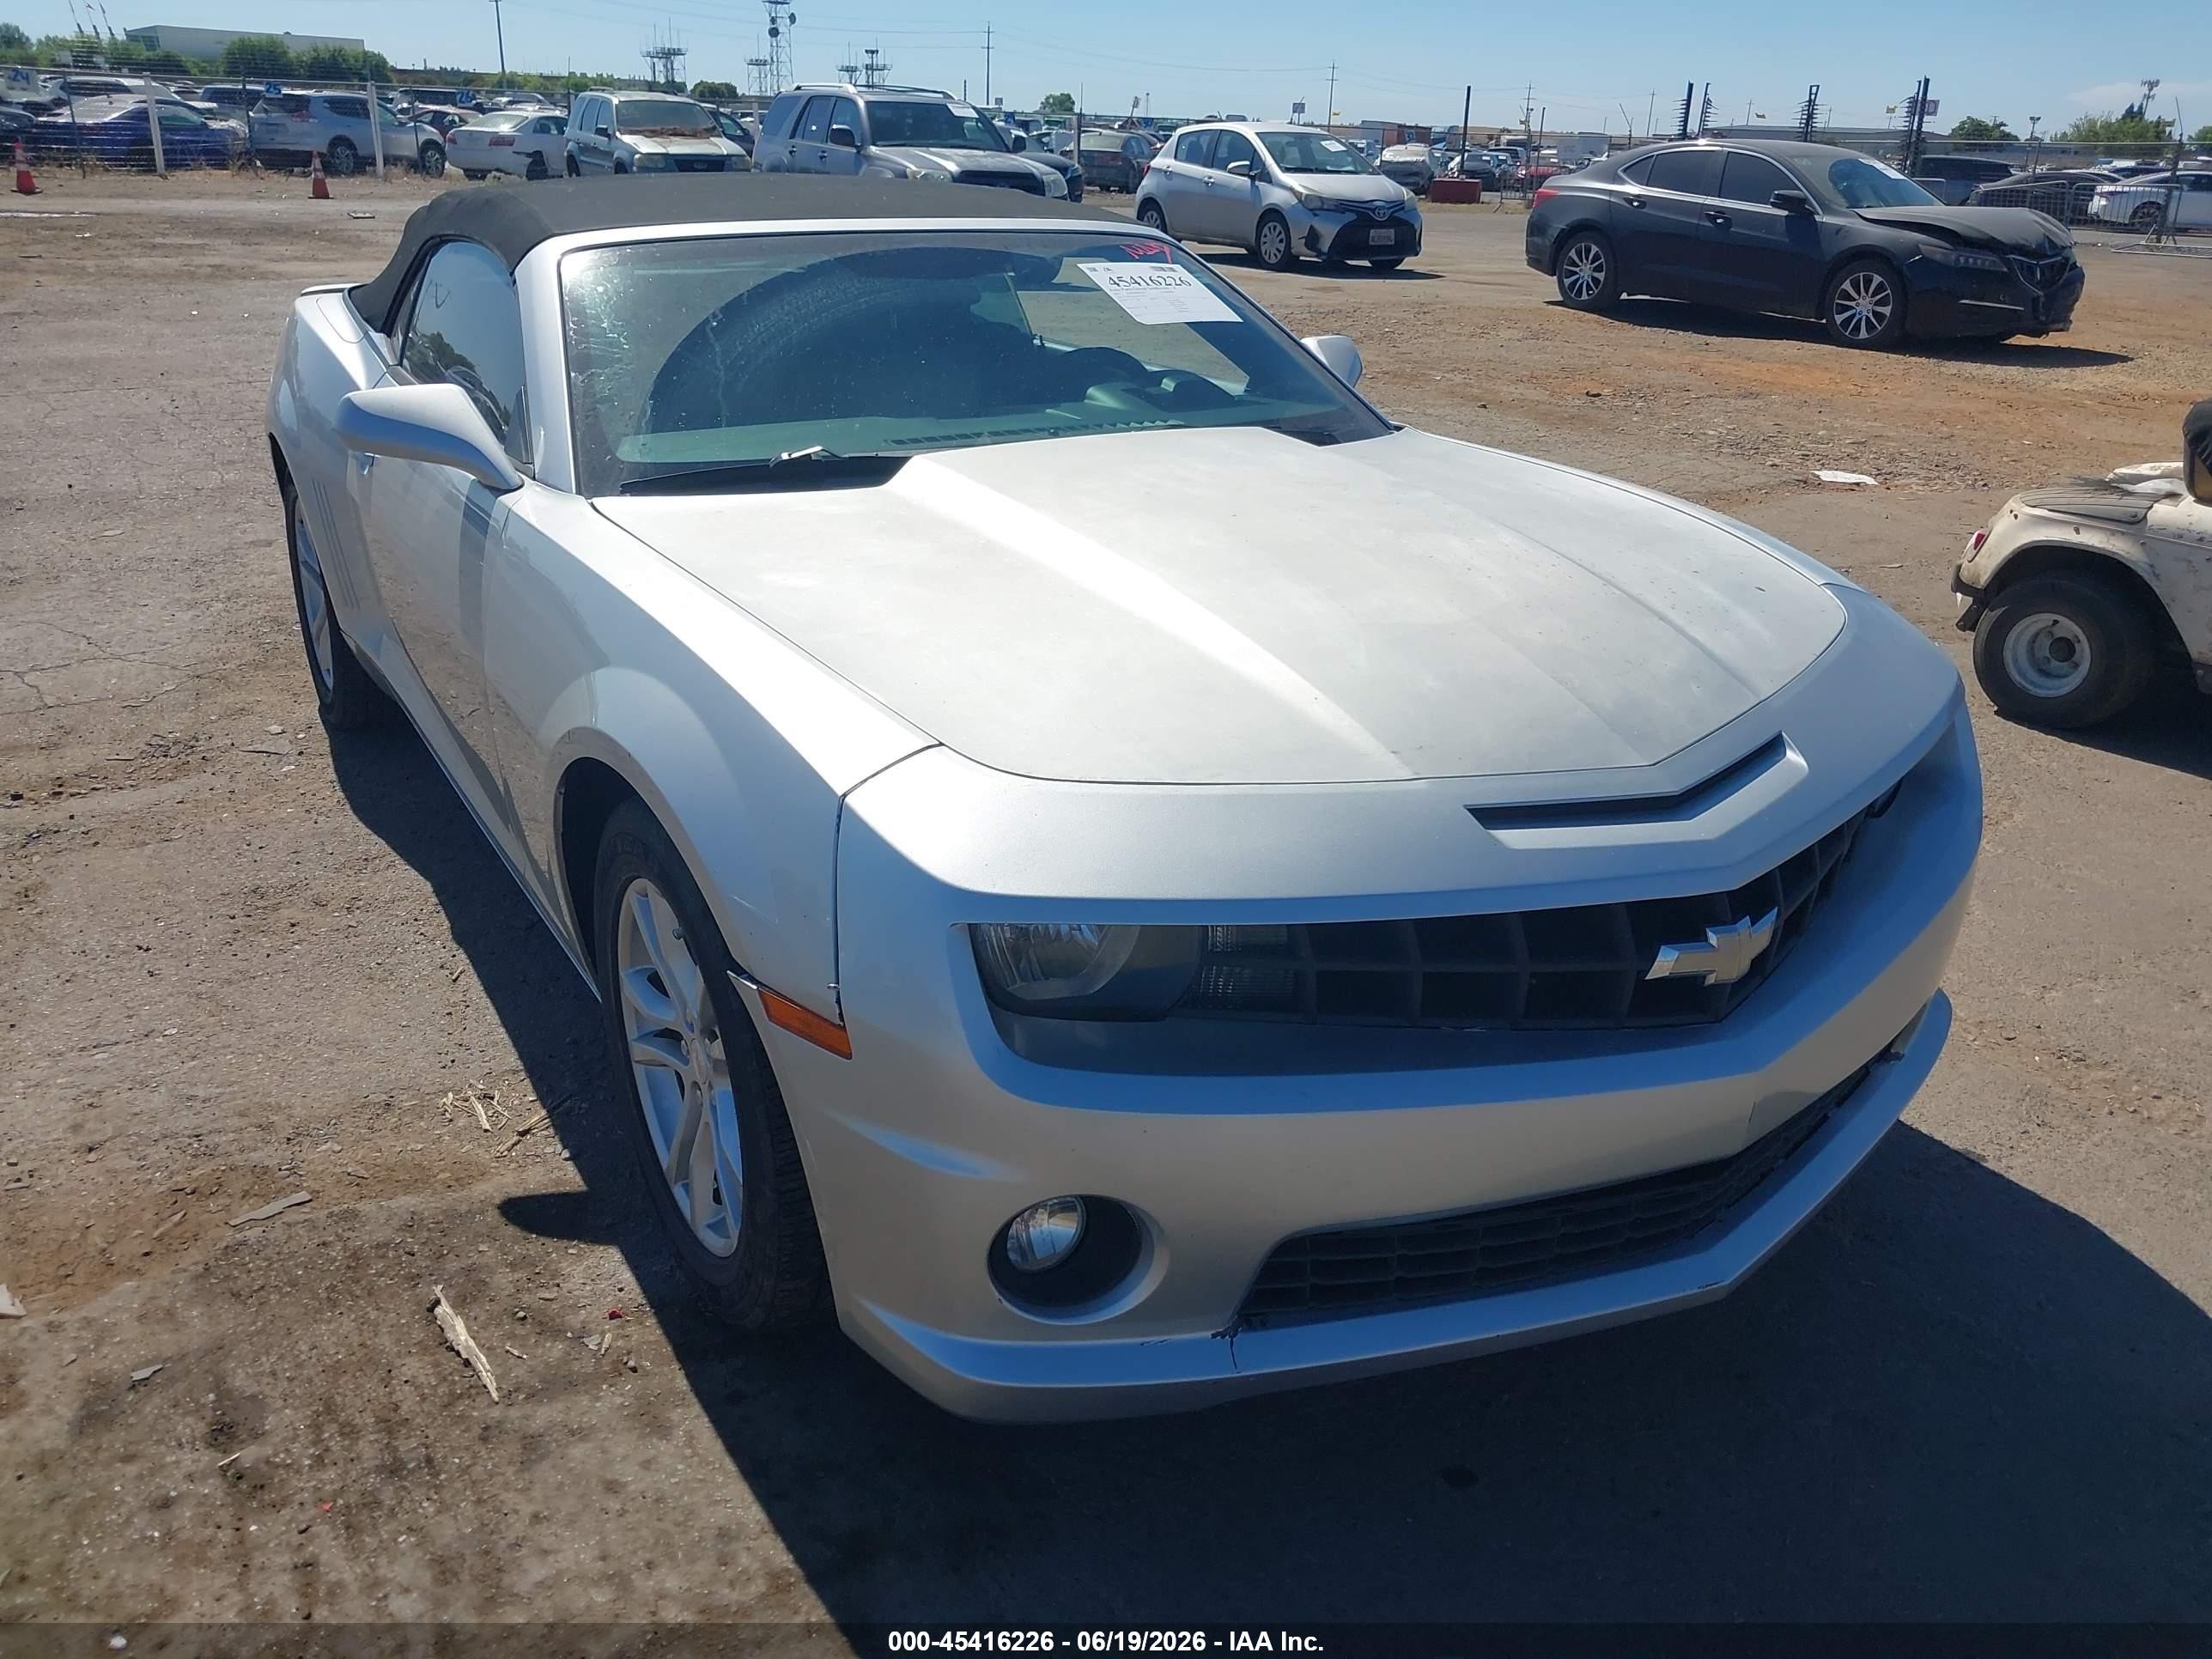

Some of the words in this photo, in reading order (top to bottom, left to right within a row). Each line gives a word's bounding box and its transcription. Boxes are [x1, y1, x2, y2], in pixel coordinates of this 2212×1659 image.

[12, 69, 31, 85] 24
[265, 82, 282, 94] 25
[1109, 275, 1192, 287] 45416226
